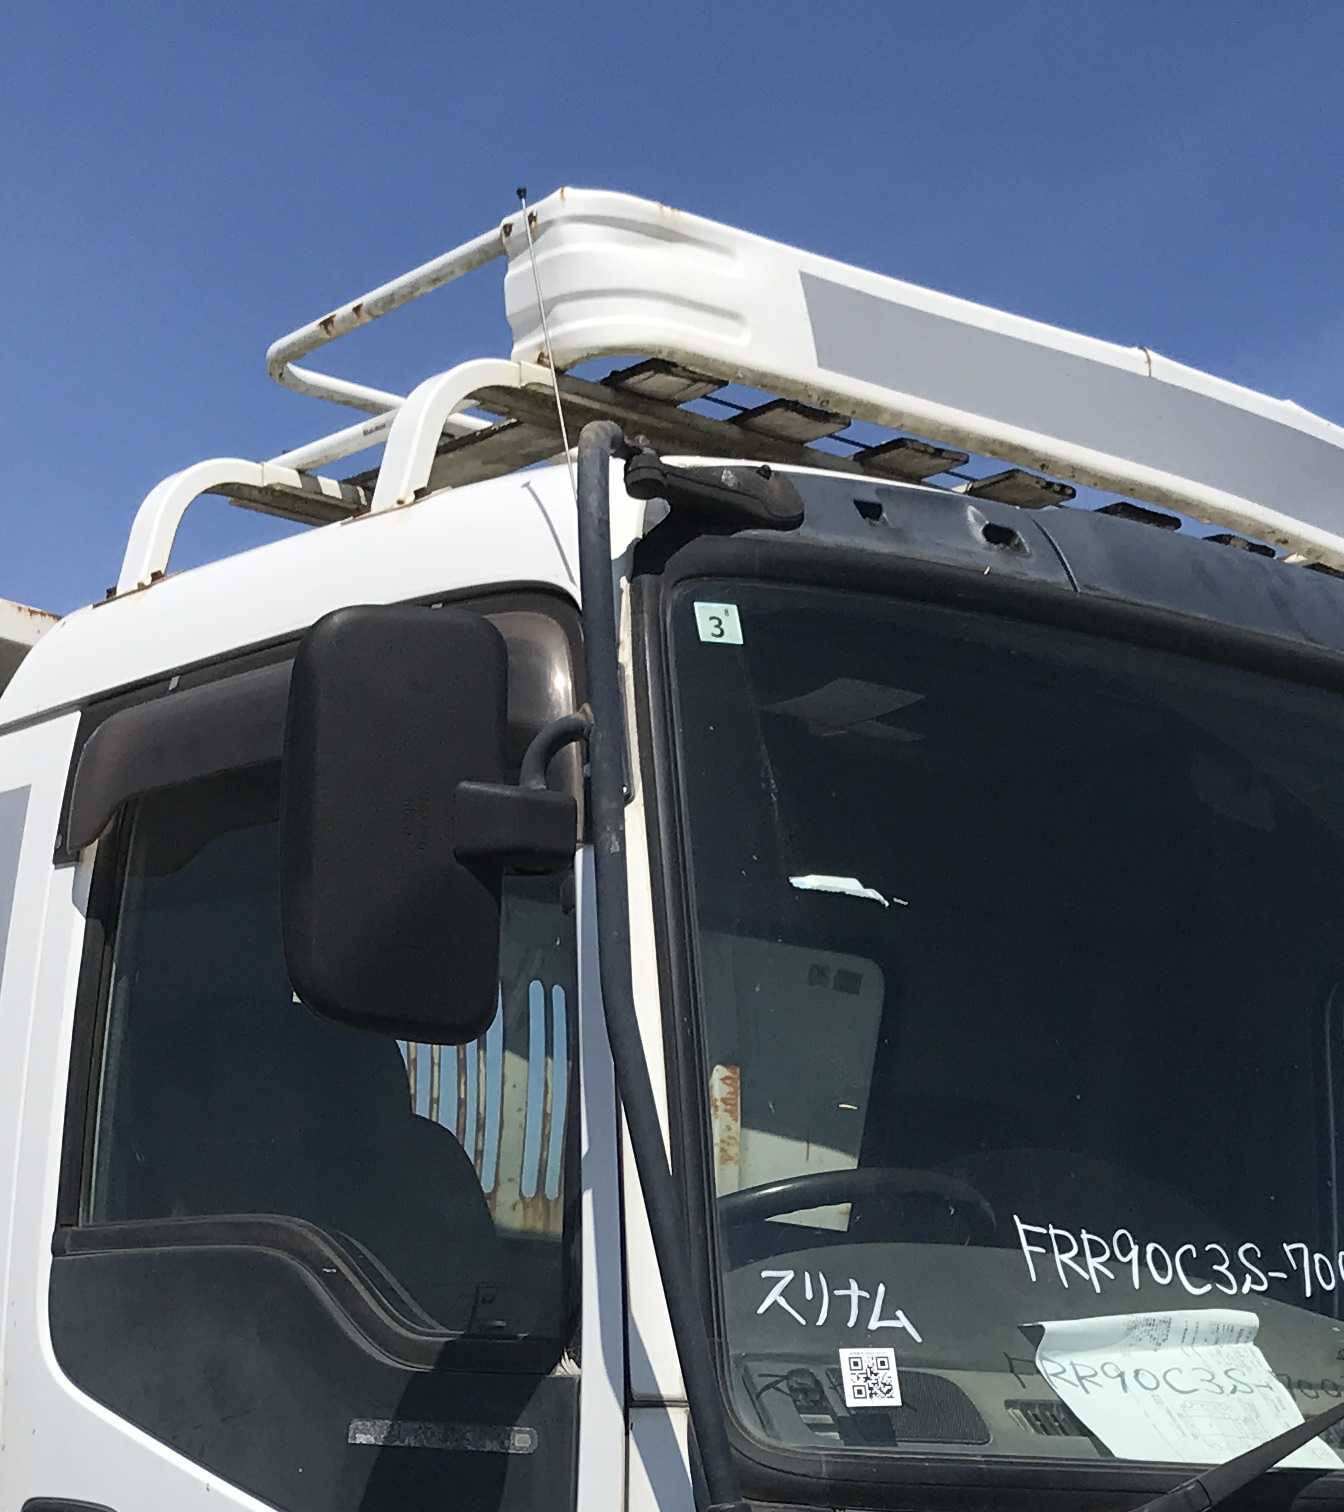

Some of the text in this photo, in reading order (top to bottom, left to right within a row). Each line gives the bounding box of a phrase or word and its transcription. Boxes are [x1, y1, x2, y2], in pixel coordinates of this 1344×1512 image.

[708, 615, 725, 638] 3
[756, 1269, 923, 1343] スリナム
